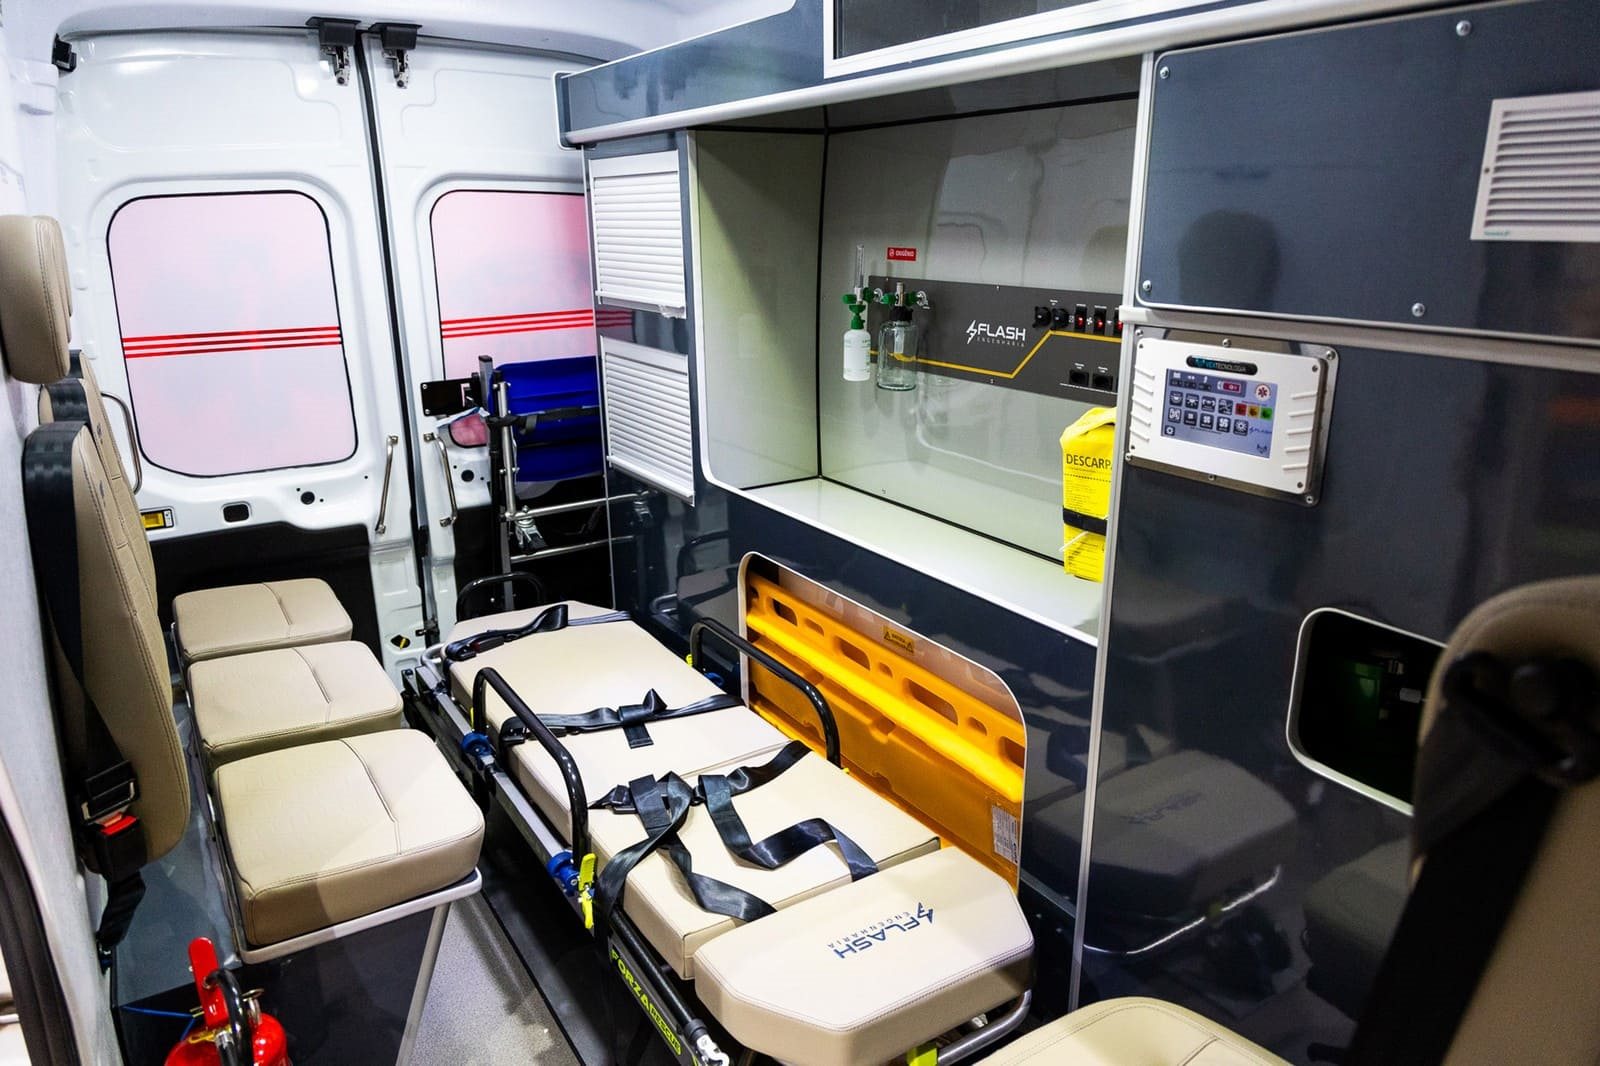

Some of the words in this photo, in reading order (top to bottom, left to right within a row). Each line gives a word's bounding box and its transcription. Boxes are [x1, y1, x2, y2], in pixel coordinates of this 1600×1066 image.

[978, 323, 1026, 341] FLASH
[1066, 453, 1112, 470] DESCARP
[828, 911, 911, 949] ENGENHARIA
[833, 916, 921, 959] FLASH
[609, 949, 650, 1010] FORZA
